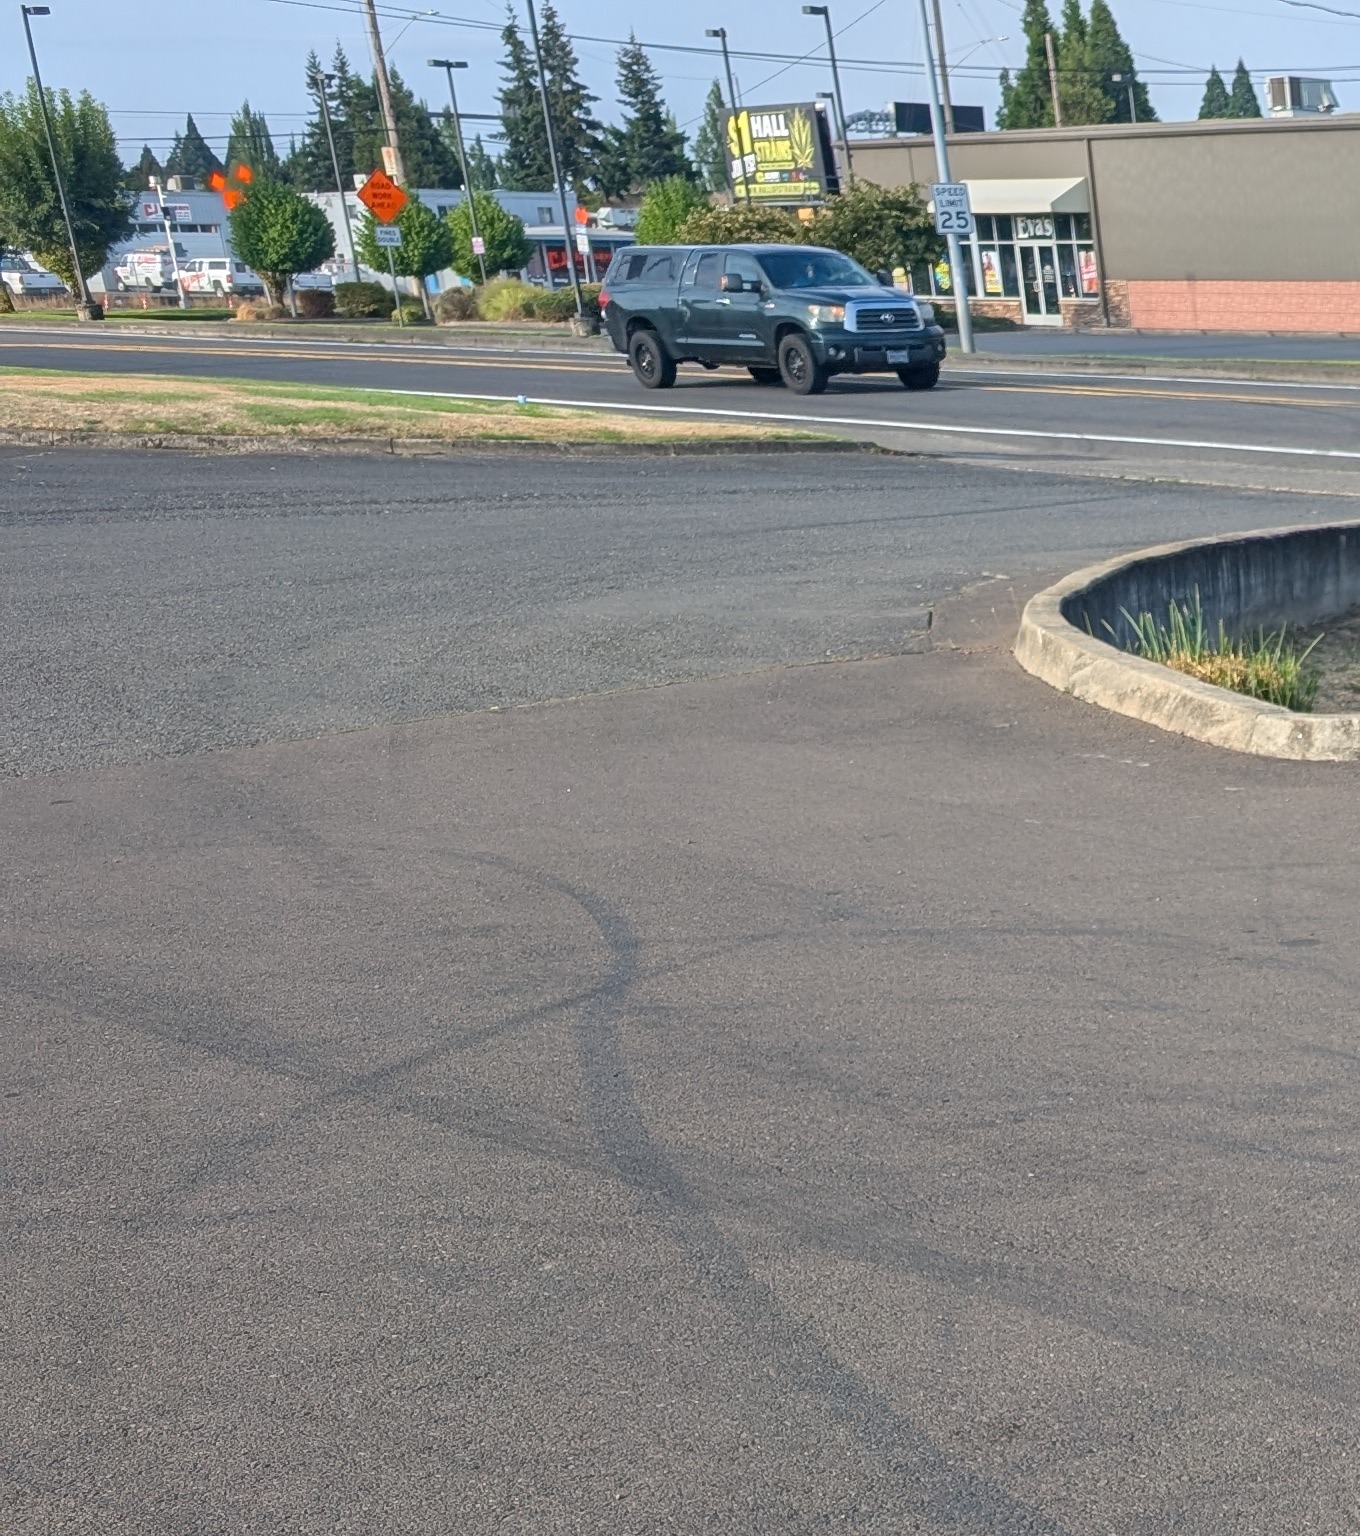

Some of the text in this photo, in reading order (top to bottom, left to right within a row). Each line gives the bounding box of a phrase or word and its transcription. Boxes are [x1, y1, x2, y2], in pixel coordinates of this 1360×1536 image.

[750, 113, 790, 138] HALL
[370, 181, 392, 190] ROAD
[371, 192, 392, 200] WORK
[935, 187, 965, 197] SPEED
[371, 201, 396, 210] AHEAD
[939, 199, 963, 208] LIMIT
[940, 211, 969, 230] 25
[1016, 215, 1053, 239] Eva's
[377, 236, 399, 244] DOUBLE
